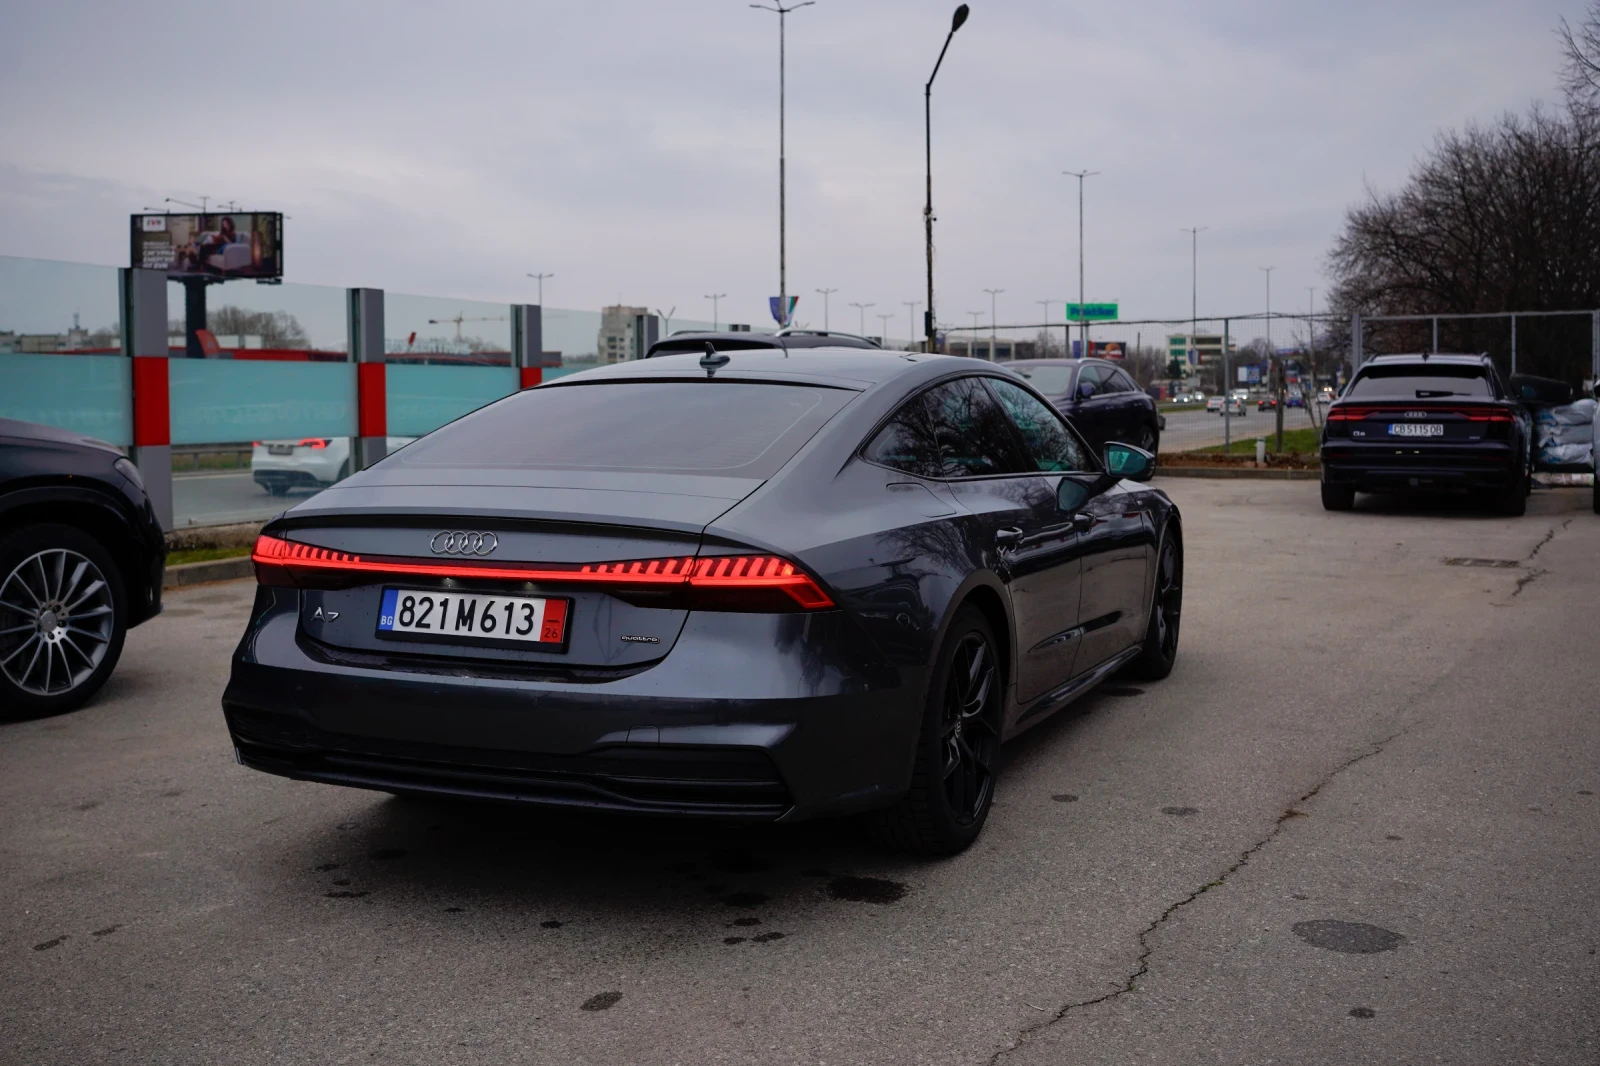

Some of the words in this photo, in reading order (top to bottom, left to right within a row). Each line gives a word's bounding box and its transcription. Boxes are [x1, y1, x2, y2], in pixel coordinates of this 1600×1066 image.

[311, 606, 339, 622] A7
[380, 615, 393, 626] BG
[398, 595, 535, 635] 821M613
[543, 627, 558, 639] 26
